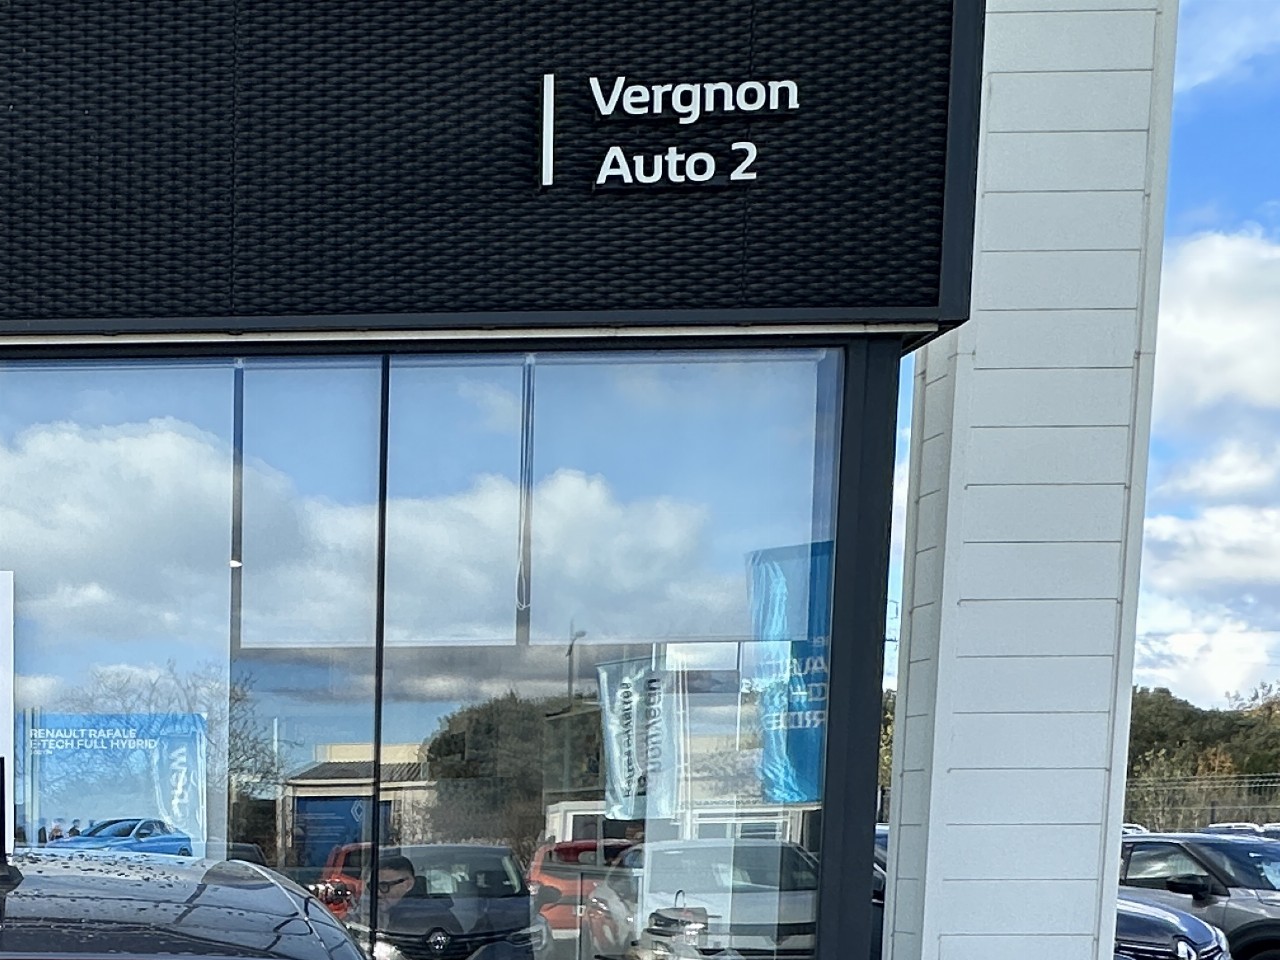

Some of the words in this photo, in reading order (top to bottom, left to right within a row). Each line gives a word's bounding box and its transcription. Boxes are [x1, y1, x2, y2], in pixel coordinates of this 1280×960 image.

[589, 76, 800, 124] Vergnon
[596, 146, 716, 185] Auto
[730, 141, 758, 181] 2
[30, 729, 88, 739] RENAULT
[89, 729, 137, 739] RAFALE
[77, 739, 108, 750] FULL
[111, 739, 158, 749] HYBRID
